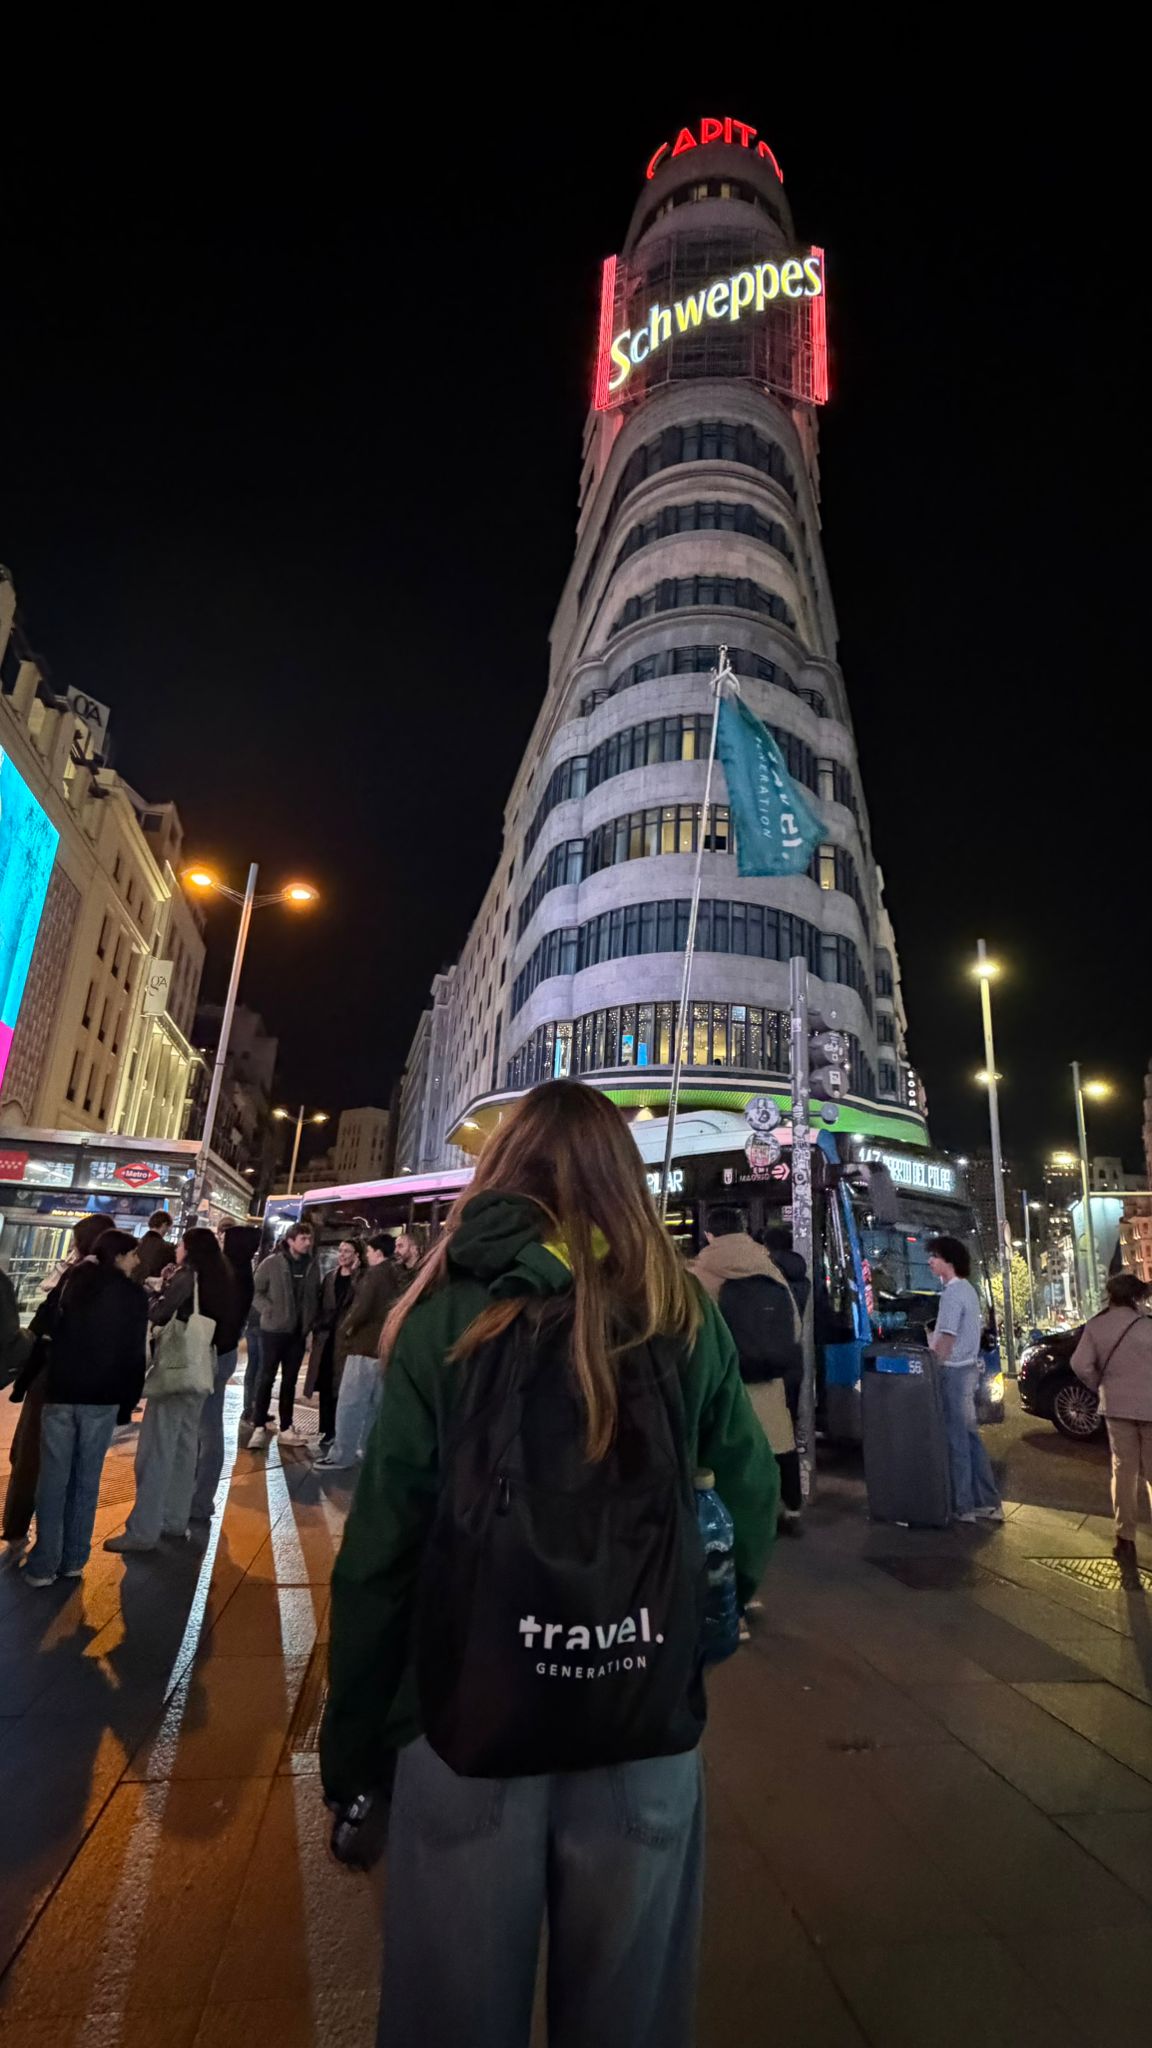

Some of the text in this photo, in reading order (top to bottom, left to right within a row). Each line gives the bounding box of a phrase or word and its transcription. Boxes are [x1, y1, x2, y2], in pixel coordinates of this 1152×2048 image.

[608, 256, 822, 392] Schweppes
[126, 1170, 148, 1179] Metro
[518, 1607, 664, 1651] travel.
[536, 1655, 648, 1680] GENERATION
